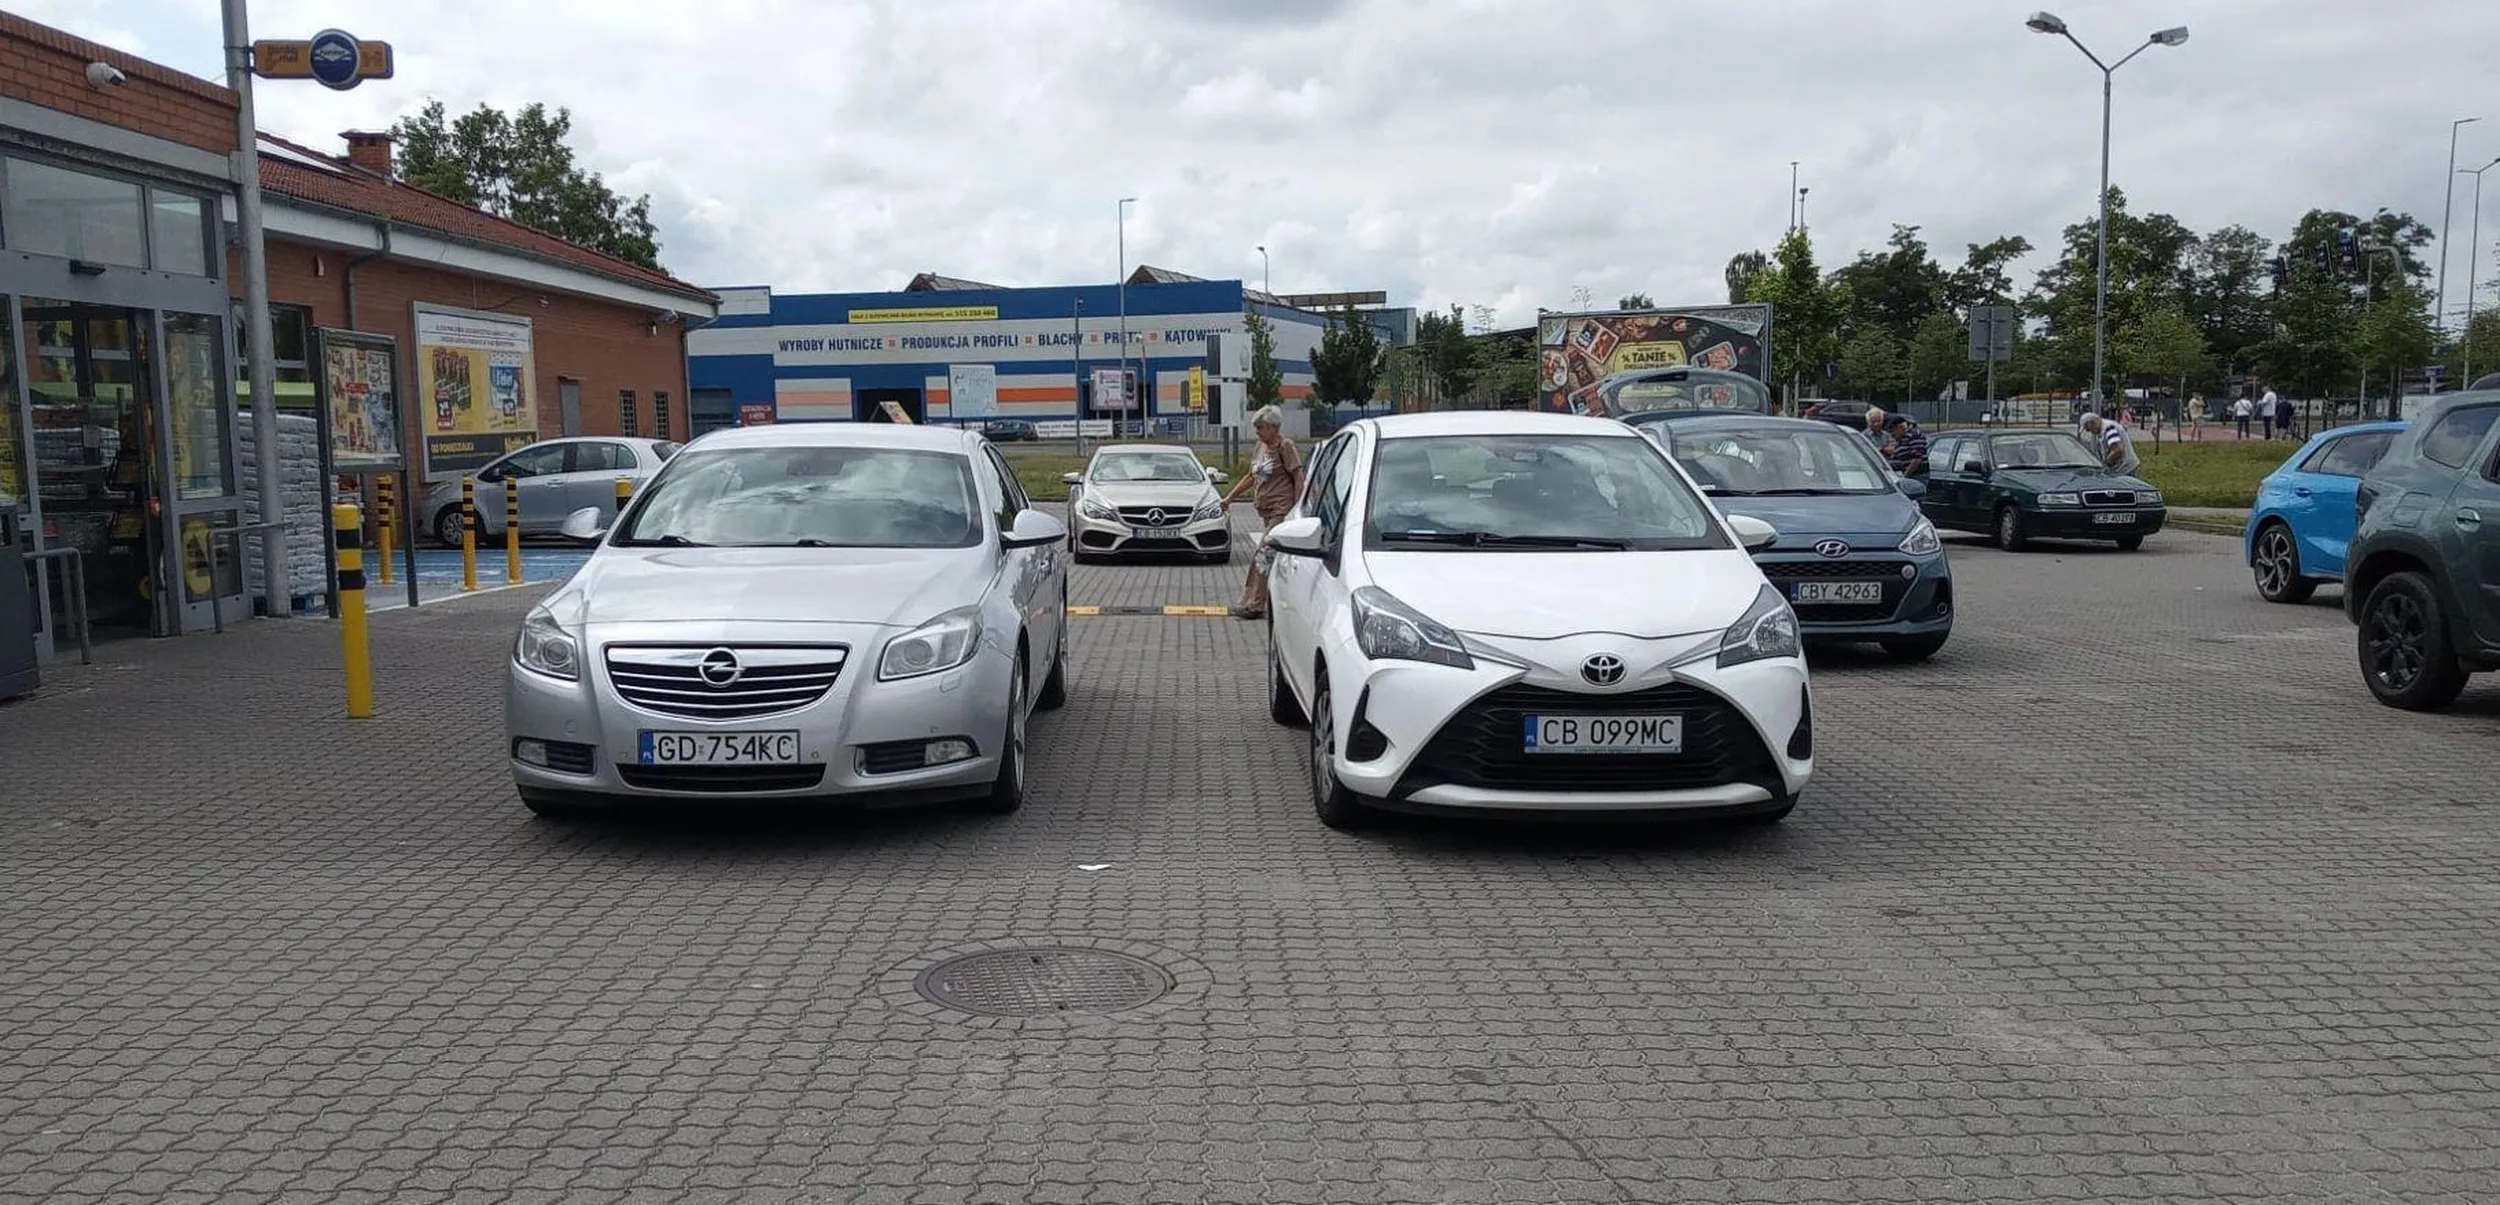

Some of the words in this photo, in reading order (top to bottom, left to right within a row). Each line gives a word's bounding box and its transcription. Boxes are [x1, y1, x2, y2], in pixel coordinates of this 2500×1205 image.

[778, 338, 824, 352] WYROBY
[828, 337, 883, 351] HUTNICZE
[902, 335, 969, 349] PRODUKCJA
[973, 334, 1019, 348] PROFILI
[1038, 333, 1083, 346] BLACHY
[1632, 351, 1667, 362] TANIE
[1801, 583, 1829, 599] CBY
[1834, 583, 1880, 599] 42963
[1543, 719, 1578, 745] CB
[1590, 719, 1675, 745] 099MC
[658, 735, 697, 761] GD
[707, 735, 792, 761] 754KC
